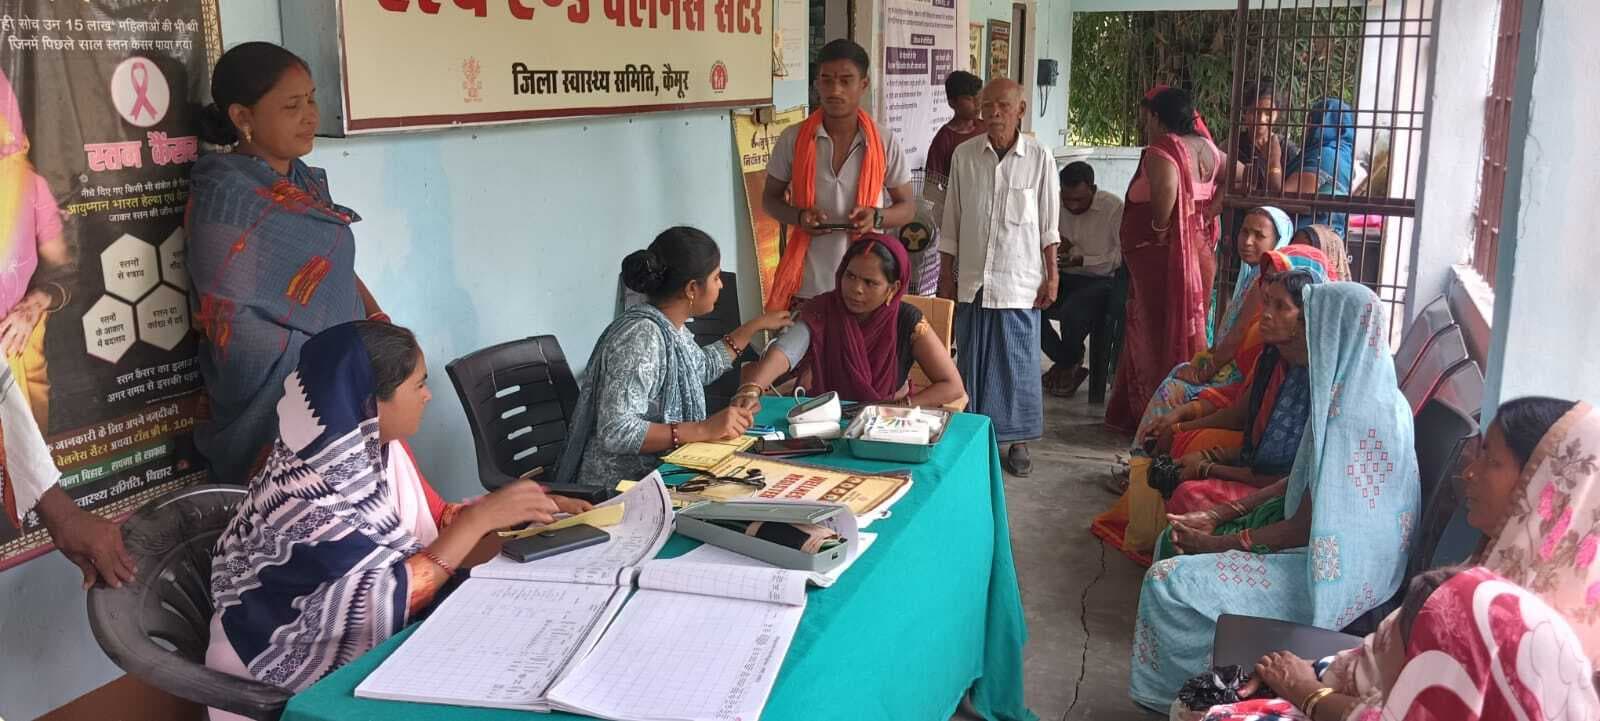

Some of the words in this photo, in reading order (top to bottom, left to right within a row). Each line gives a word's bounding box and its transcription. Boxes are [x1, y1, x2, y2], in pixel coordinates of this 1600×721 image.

[18, 15, 40, 31] सोच
[42, 18, 61, 31] उन
[66, 18, 83, 31] 15
[161, 18, 173, 32] की
[174, 18, 186, 33] भी
[42, 35, 75, 50] पिछले
[79, 39, 103, 50] साल
[106, 39, 128, 50] स्तन
[511, 62, 558, 95] जिला
[561, 69, 610, 94] स्वास्थ्य
[614, 64, 659, 96] समिति,
[662, 63, 690, 98] कैमूर
[84, 141, 142, 171] स्तन
[66, 199, 109, 216] आयुष्मान
[112, 196, 139, 209] भारत
[116, 372, 134, 384] स्तन
[157, 364, 169, 374] का
[107, 390, 126, 402] अगर
[126, 384, 145, 397] समय
[147, 380, 154, 391] से
[157, 374, 182, 390] इसकी
[56, 430, 96, 450] जानकारी
[98, 424, 107, 438] के
[108, 423, 123, 436] लिए
[57, 449, 88, 467] वेलनेस
[110, 476, 144, 497] समिति,
[146, 465, 173, 482] बिहार
